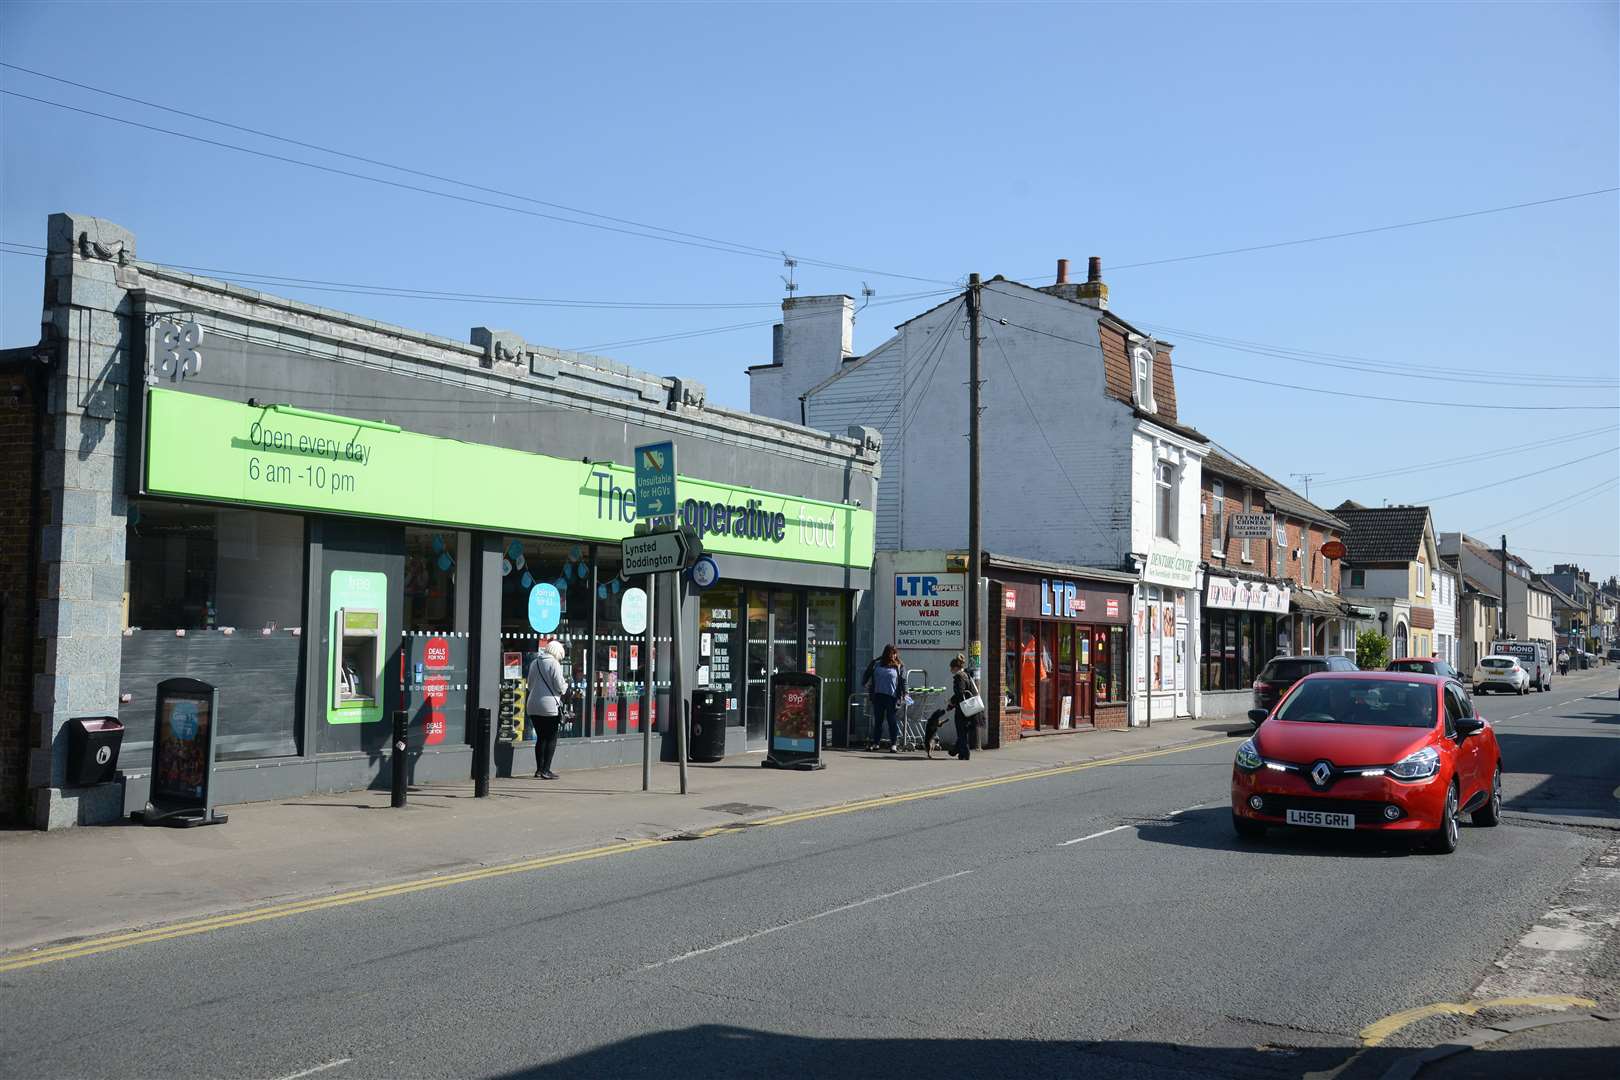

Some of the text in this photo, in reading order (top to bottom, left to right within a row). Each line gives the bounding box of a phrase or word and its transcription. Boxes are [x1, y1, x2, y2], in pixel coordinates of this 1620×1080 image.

[250, 422, 371, 466] Open every day
[249, 457, 260, 480] 6
[266, 464, 291, 484] am
[331, 472, 354, 494] pm
[638, 475, 672, 487] Unsuitable
[640, 486, 670, 498] for HGVs
[592, 471, 637, 524] The
[799, 505, 837, 549] food
[625, 541, 657, 556] Lynsted
[626, 555, 673, 569] Doddington
[896, 576, 964, 596] LTR SUPPLIES
[900, 599, 960, 607] WORK & LEISURE
[1041, 579, 1077, 617] LTR
[428, 647, 446, 655] DEALS
[787, 693, 804, 704] 89p
[1290, 811, 1350, 826] LH55 GRH
